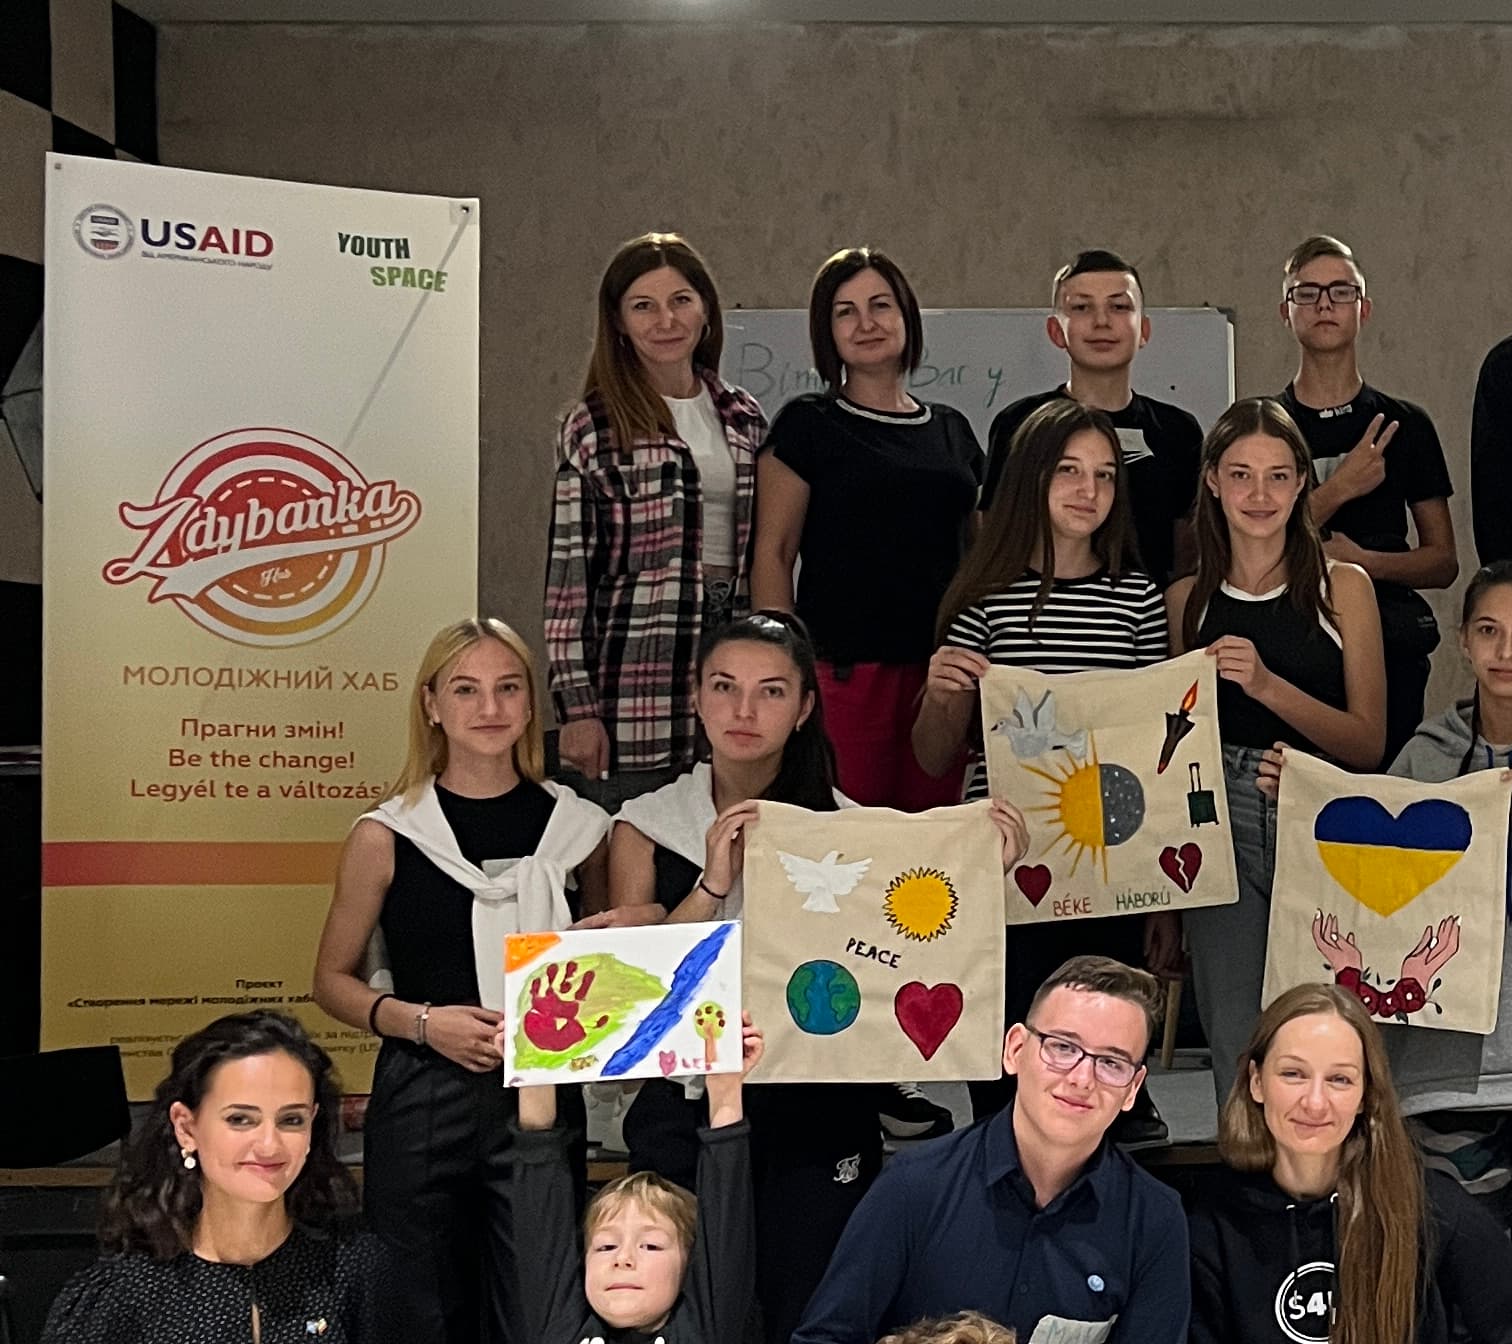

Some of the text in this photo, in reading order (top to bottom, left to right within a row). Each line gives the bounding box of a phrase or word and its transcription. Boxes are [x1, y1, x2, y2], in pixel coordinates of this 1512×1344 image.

[140, 218, 274, 258] USAID
[337, 232, 411, 259] YOUTH
[370, 266, 448, 293] SPACE
[122, 665, 399, 691] МОЛОДІЖНИЙ ХАБ
[180, 718, 344, 741] Прагни змін!
[168, 749, 355, 773] Be the change!
[130, 778, 216, 802] Legyél
[225, 780, 248, 798] te
[257, 786, 271, 798] a
[1052, 892, 1093, 917] BÉKE
[845, 937, 902, 969] PEACE
